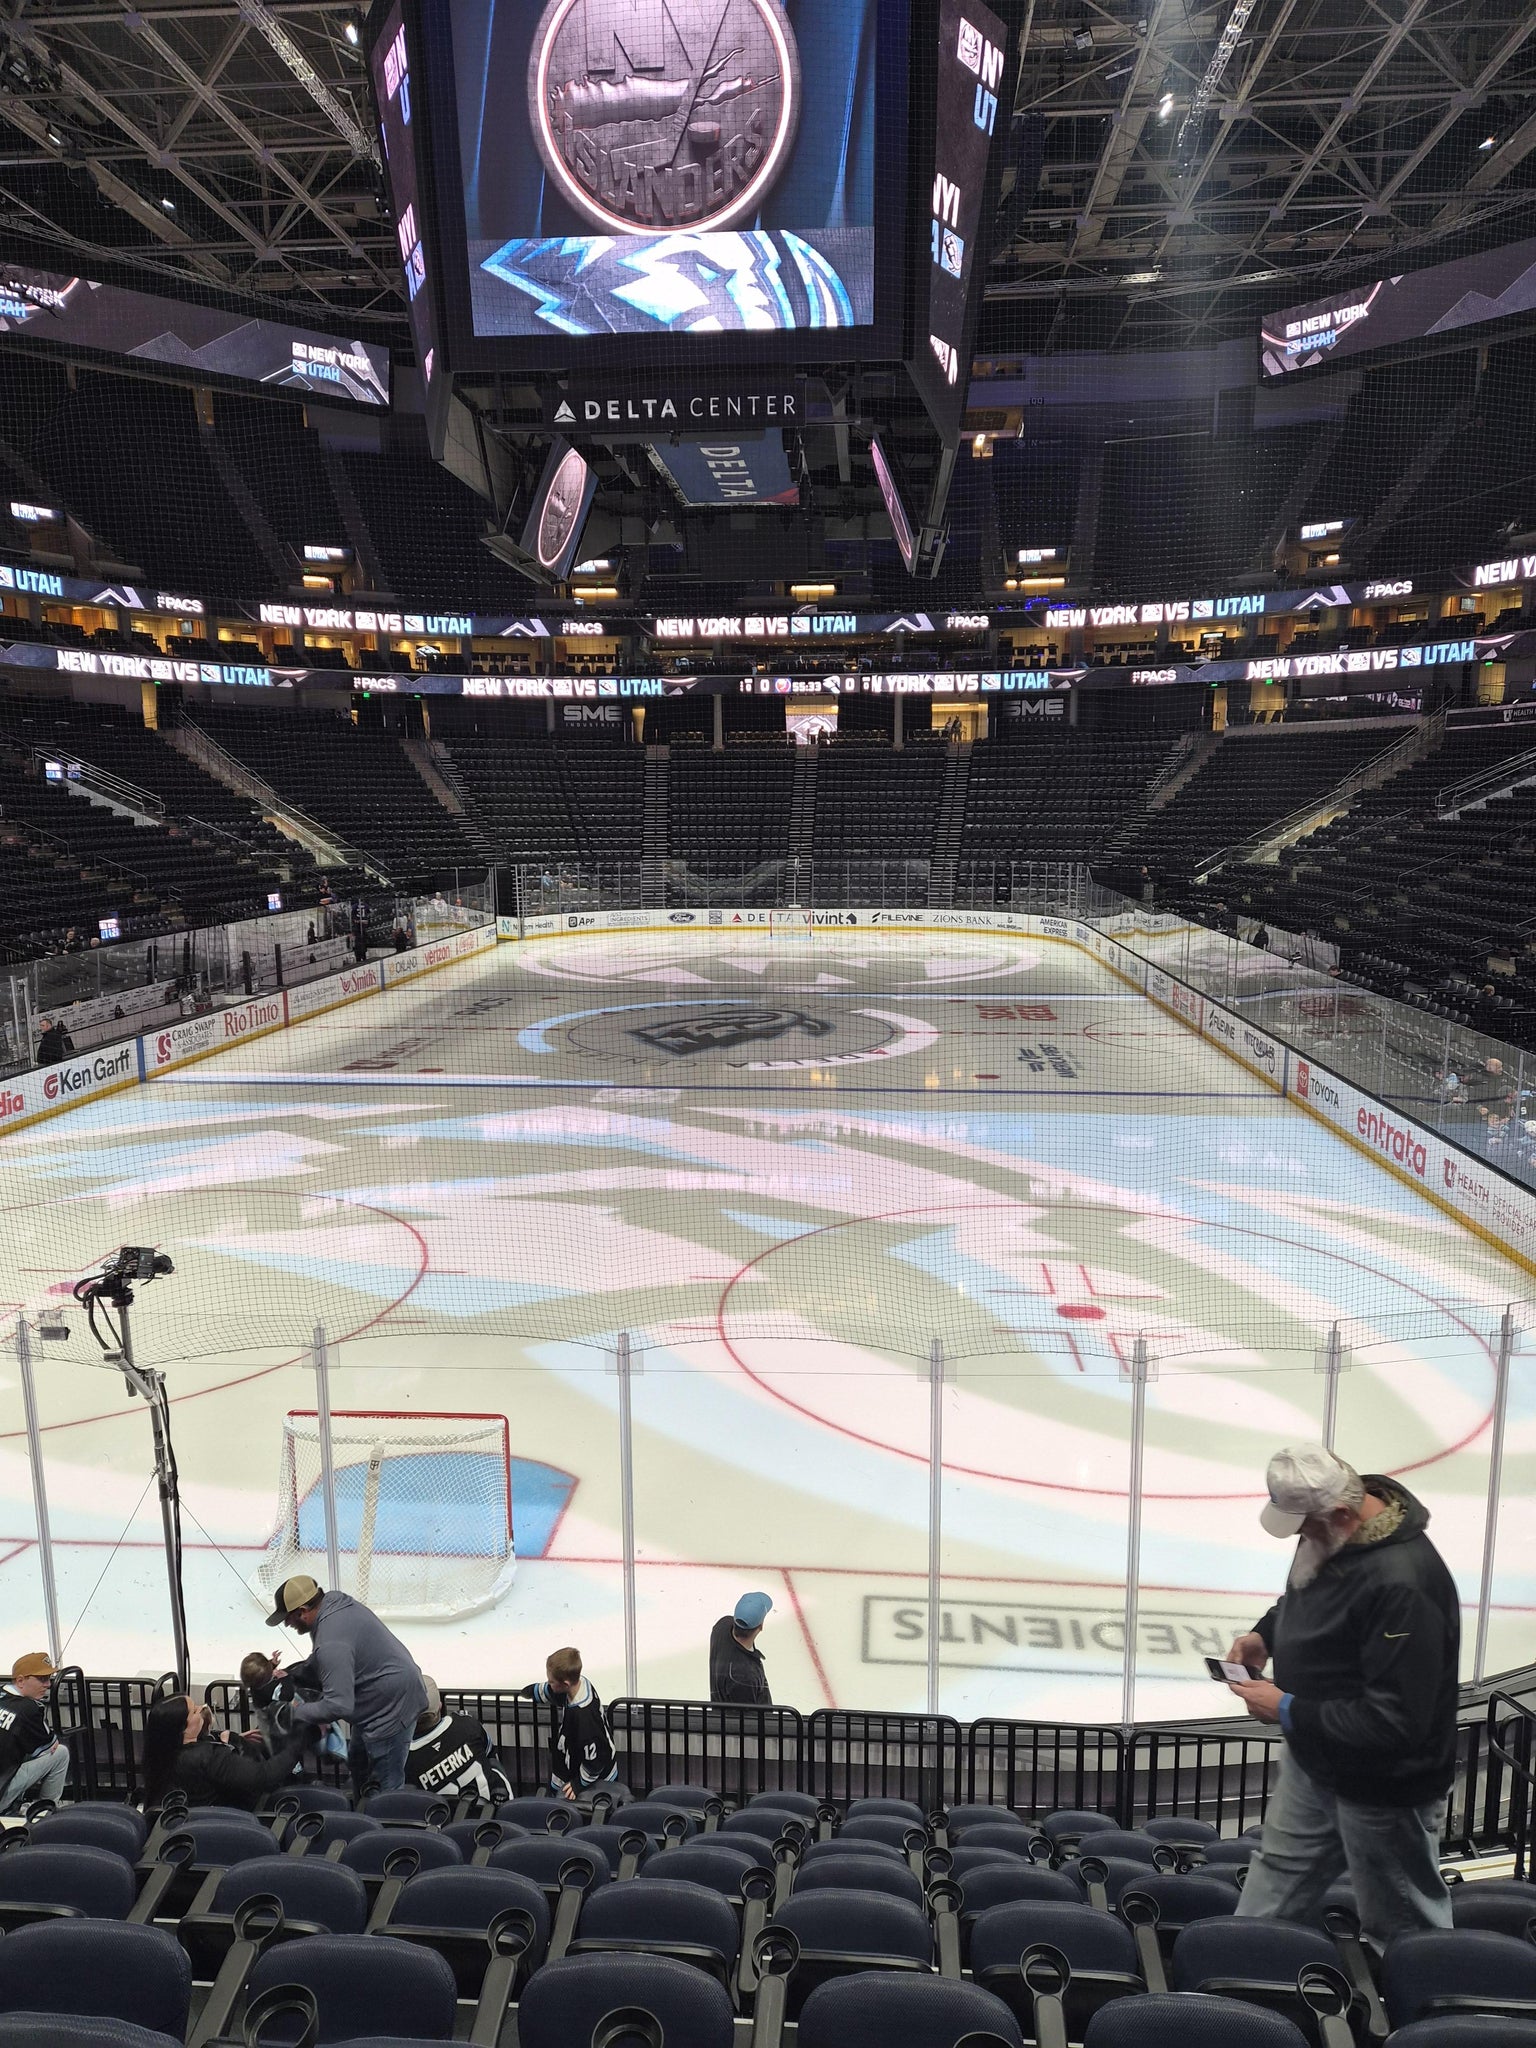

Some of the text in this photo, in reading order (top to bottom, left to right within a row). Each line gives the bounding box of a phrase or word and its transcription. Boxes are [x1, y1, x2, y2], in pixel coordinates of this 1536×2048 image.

[1302, 302, 1369, 334] NEW YORK
[1302, 329, 1336, 351] UTAH
[308, 345, 370, 372] NEW YORK
[308, 364, 340, 381] UTAH
[584, 395, 796, 420] DELTA CENTER
[700, 446, 758, 498] DELTA
[15, 569, 63, 597] UTAH
[1475, 559, 1518, 586] NEW
[1374, 581, 1413, 598] PACS
[165, 598, 204, 614] PACS
[1046, 595, 1265, 628] NEW YORK VS UTAH
[259, 603, 472, 635] NEW YORK VS UTAH
[568, 622, 603, 635] PACS
[656, 615, 857, 636] NEW YORK VS UTAH
[955, 615, 990, 628] PACS
[57, 650, 271, 687] NEW YORK VS UTAH
[1247, 640, 1476, 680] NEW YORK VS UTAH
[362, 676, 397, 690] PACS
[462, 677, 662, 696] NEW YORK VS UTAH
[760, 679, 770, 692] 0
[845, 677, 855, 691] 0
[886, 674, 930, 692] YORK
[955, 674, 979, 691] VS
[1003, 671, 1050, 690] UTAH
[1140, 670, 1177, 683] PACS
[564, 705, 622, 721] SME
[1004, 699, 1064, 716] SME
[748, 913, 795, 922] DELTA
[882, 914, 924, 922] FILEVINE
[932, 914, 992, 925] ZIONS BANK
[1040, 918, 1068, 928] AMERICAN
[424, 945, 451, 966] verizon
[351, 969, 377, 993] Smith's
[172, 1018, 216, 1042] CRAIG SWAPP
[224, 1003, 279, 1037] Rio Tinto
[60, 1049, 130, 1094] Ken Garff
[1311, 1078, 1340, 1109] TOYOTA
[1357, 1107, 1427, 1178] entrata
[1458, 1173, 1490, 1204] HEALTH
[1493, 1195, 1525, 1223] OFFICIAL
[1492, 1208, 1525, 1239] PROVIDER
[584, 1742, 597, 1761] 12
[419, 1743, 474, 1790] PETERKA
